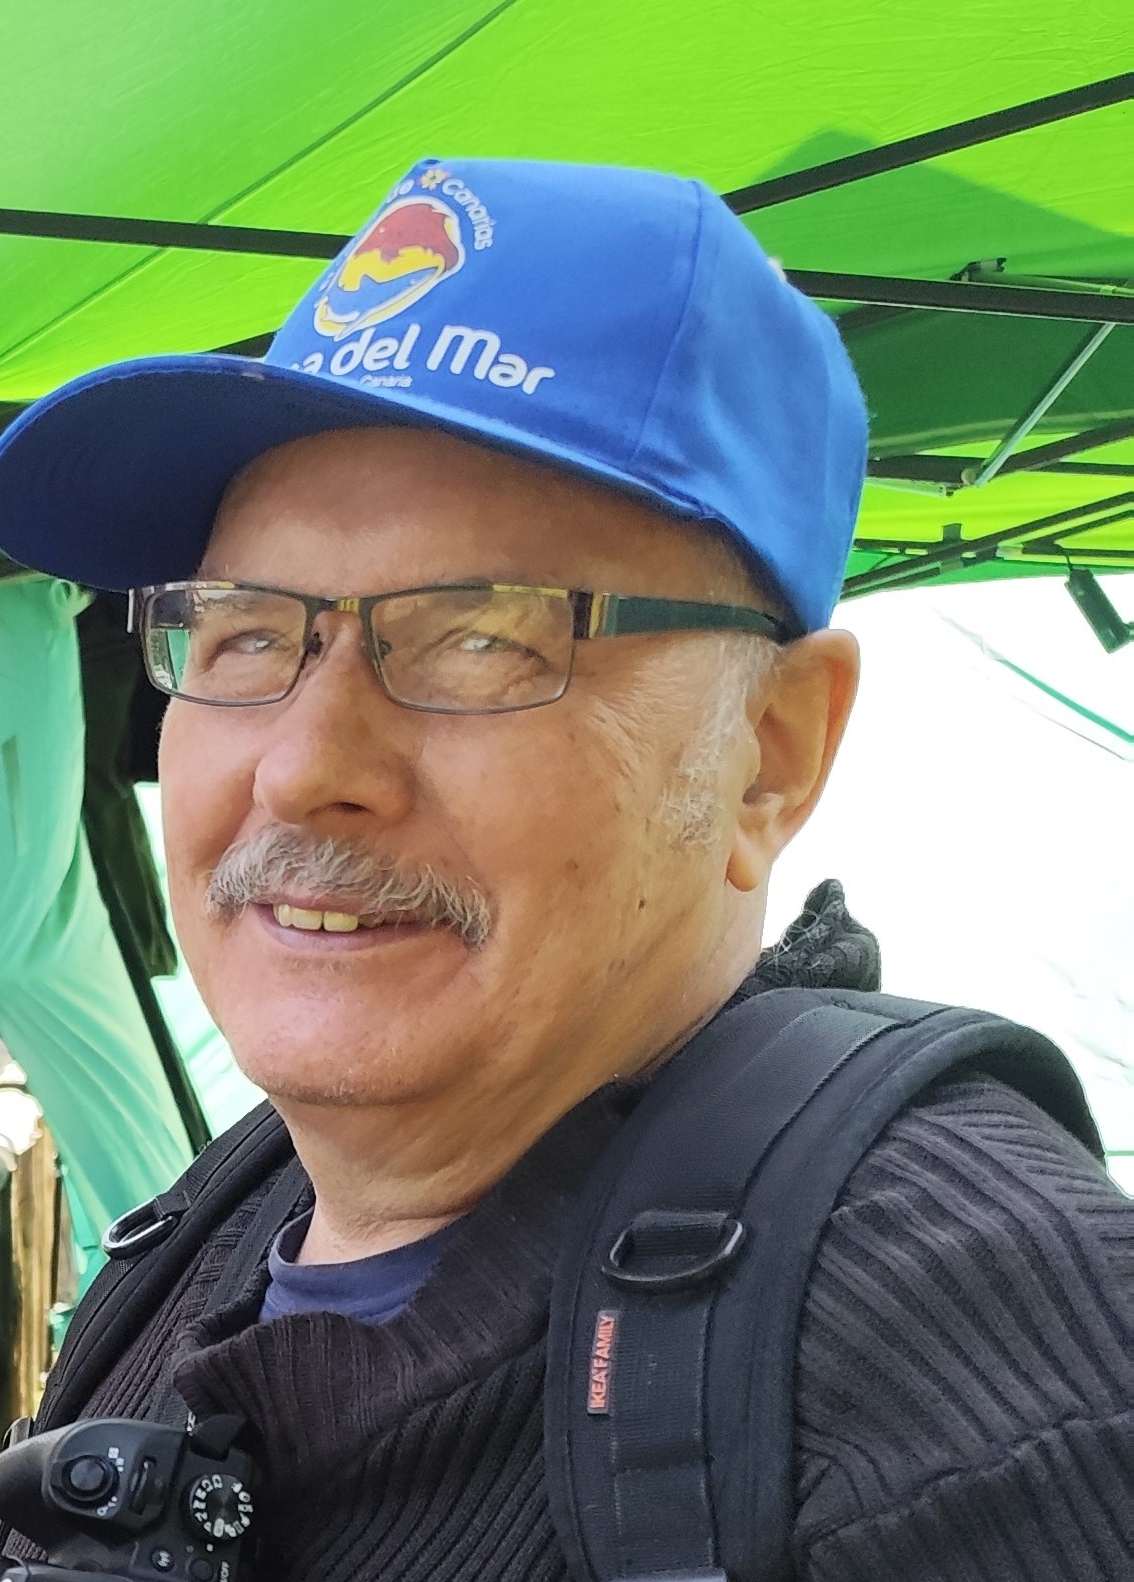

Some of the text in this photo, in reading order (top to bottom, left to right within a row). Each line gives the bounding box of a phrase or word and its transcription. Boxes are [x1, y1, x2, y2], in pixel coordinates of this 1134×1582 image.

[442, 178, 497, 251] Canarias
[330, 323, 422, 376] del
[425, 325, 556, 395] Mar
[594, 1315, 616, 1368] FAMILY
